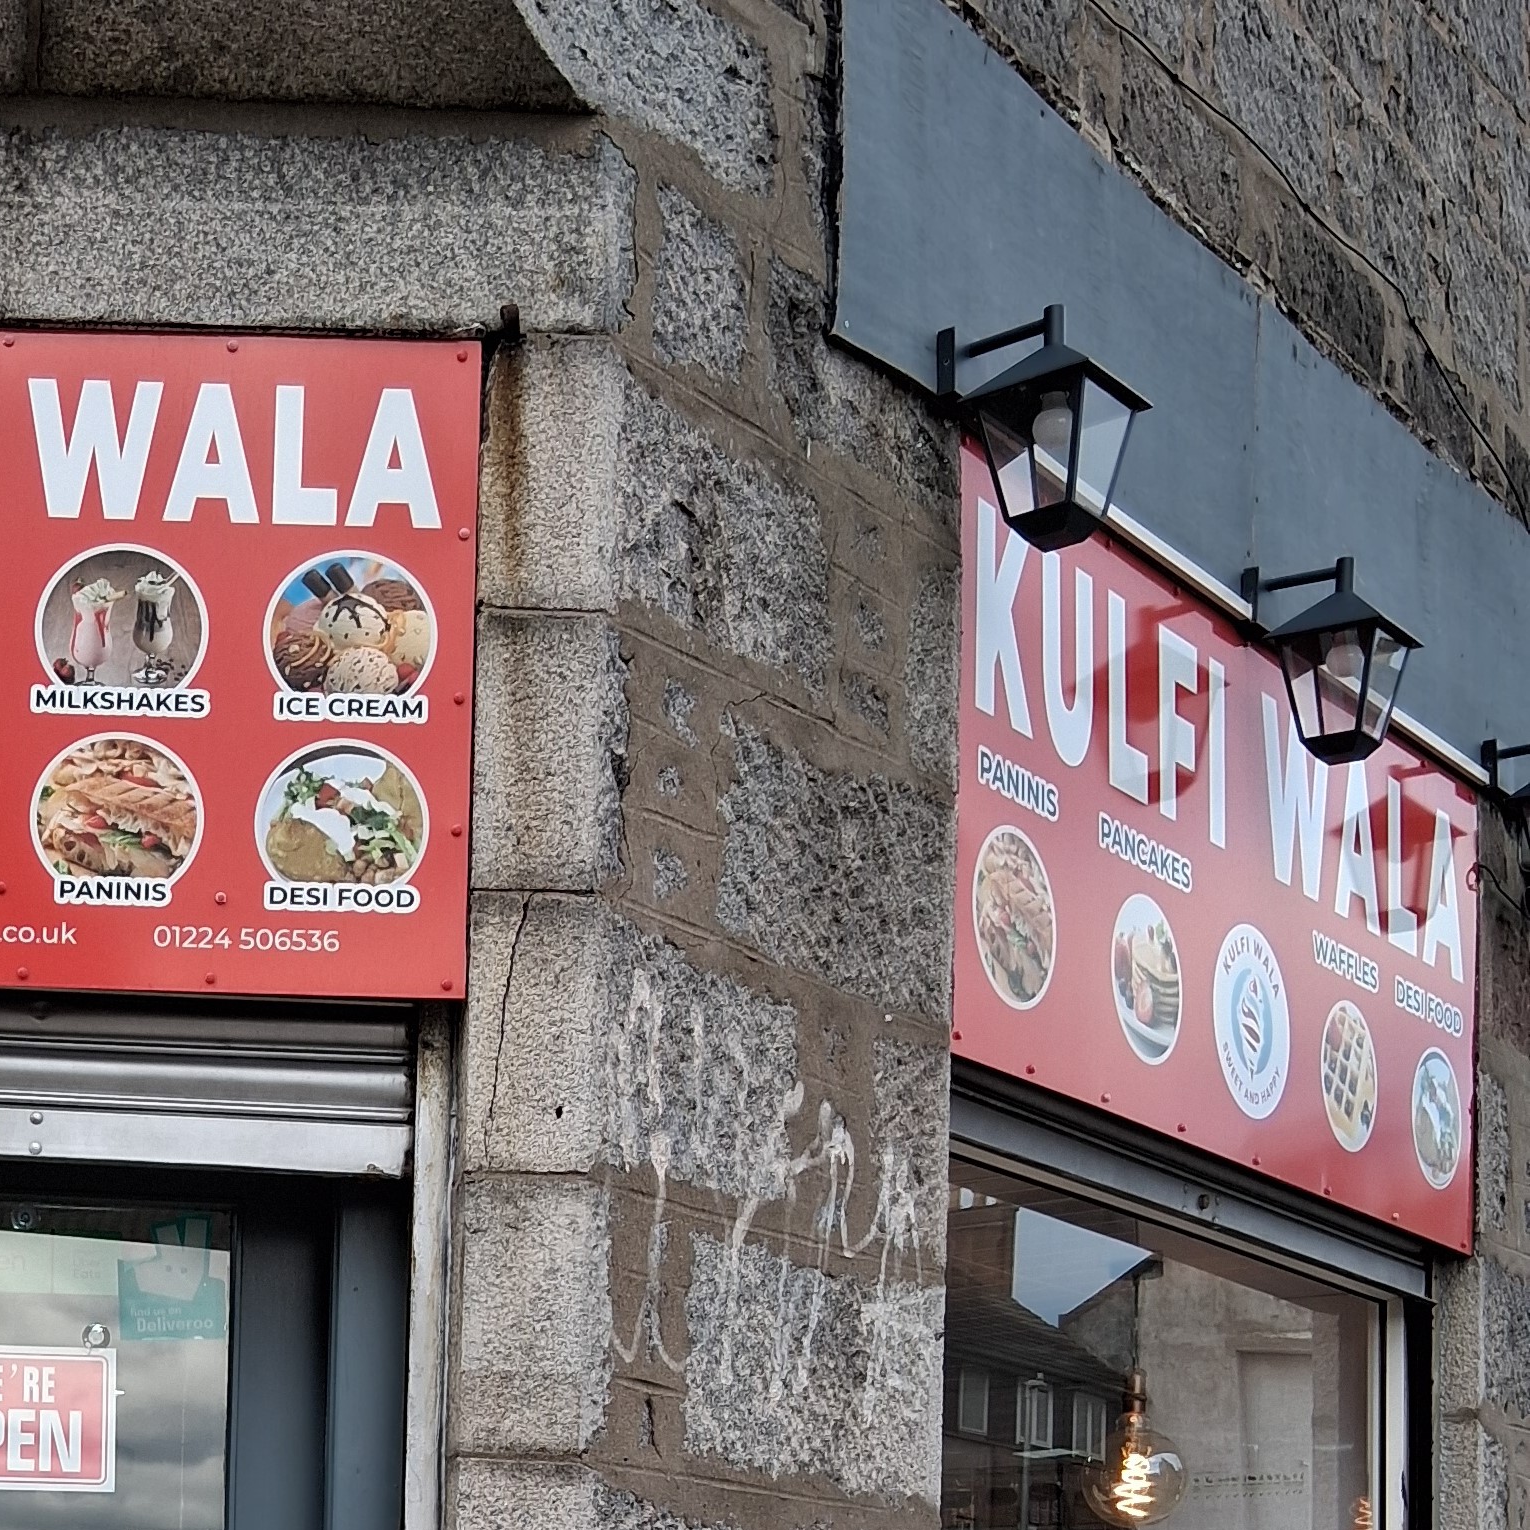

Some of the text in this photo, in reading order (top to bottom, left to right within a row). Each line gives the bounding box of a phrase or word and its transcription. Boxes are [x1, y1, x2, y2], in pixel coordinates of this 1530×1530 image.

[28, 377, 444, 529] WALA
[35, 689, 206, 713] MILKSHAKES
[278, 697, 424, 719] ICE CREAM
[975, 498, 1465, 983] KULFI WALA
[981, 751, 1057, 817] PANINIS
[1101, 817, 1191, 889] PANCAKES
[59, 880, 167, 901] PANINIS
[269, 886, 415, 909] DESI FOOD
[153, 925, 340, 952] 01224 506536
[1314, 932, 1379, 990] WAFFLES
[1223, 936, 1279, 998] KULFI WALA
[1396, 980, 1462, 1034] DESI FOOD
[136, 1316, 214, 1332] Deliveroo
